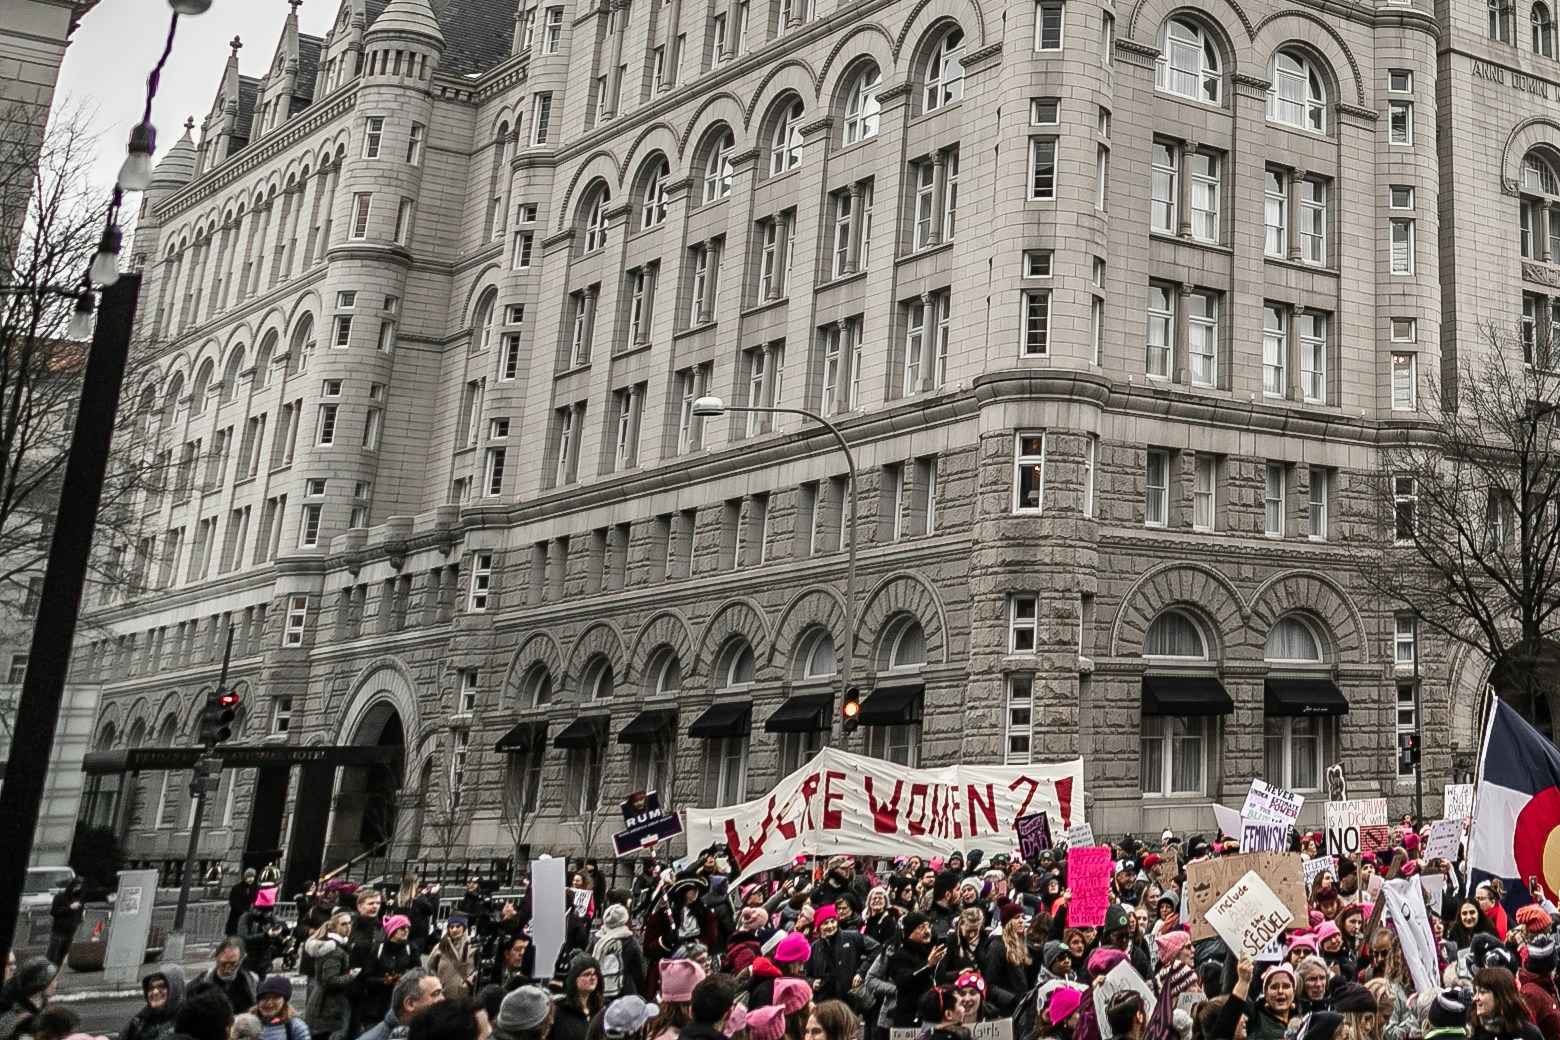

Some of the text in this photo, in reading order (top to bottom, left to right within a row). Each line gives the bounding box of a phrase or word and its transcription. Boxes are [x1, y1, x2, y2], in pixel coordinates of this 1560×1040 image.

[1265, 783, 1295, 802] NEVER
[1269, 800, 1298, 819] POWER
[1022, 834, 1048, 858] DAD
[1243, 824, 1287, 854] FEMINISM
[1329, 826, 1359, 856] NO
[1217, 884, 1249, 916] include
[1251, 913, 1267, 929] the
[1243, 910, 1291, 957] SEQUEL
[973, 1022, 1000, 1038] Girls
